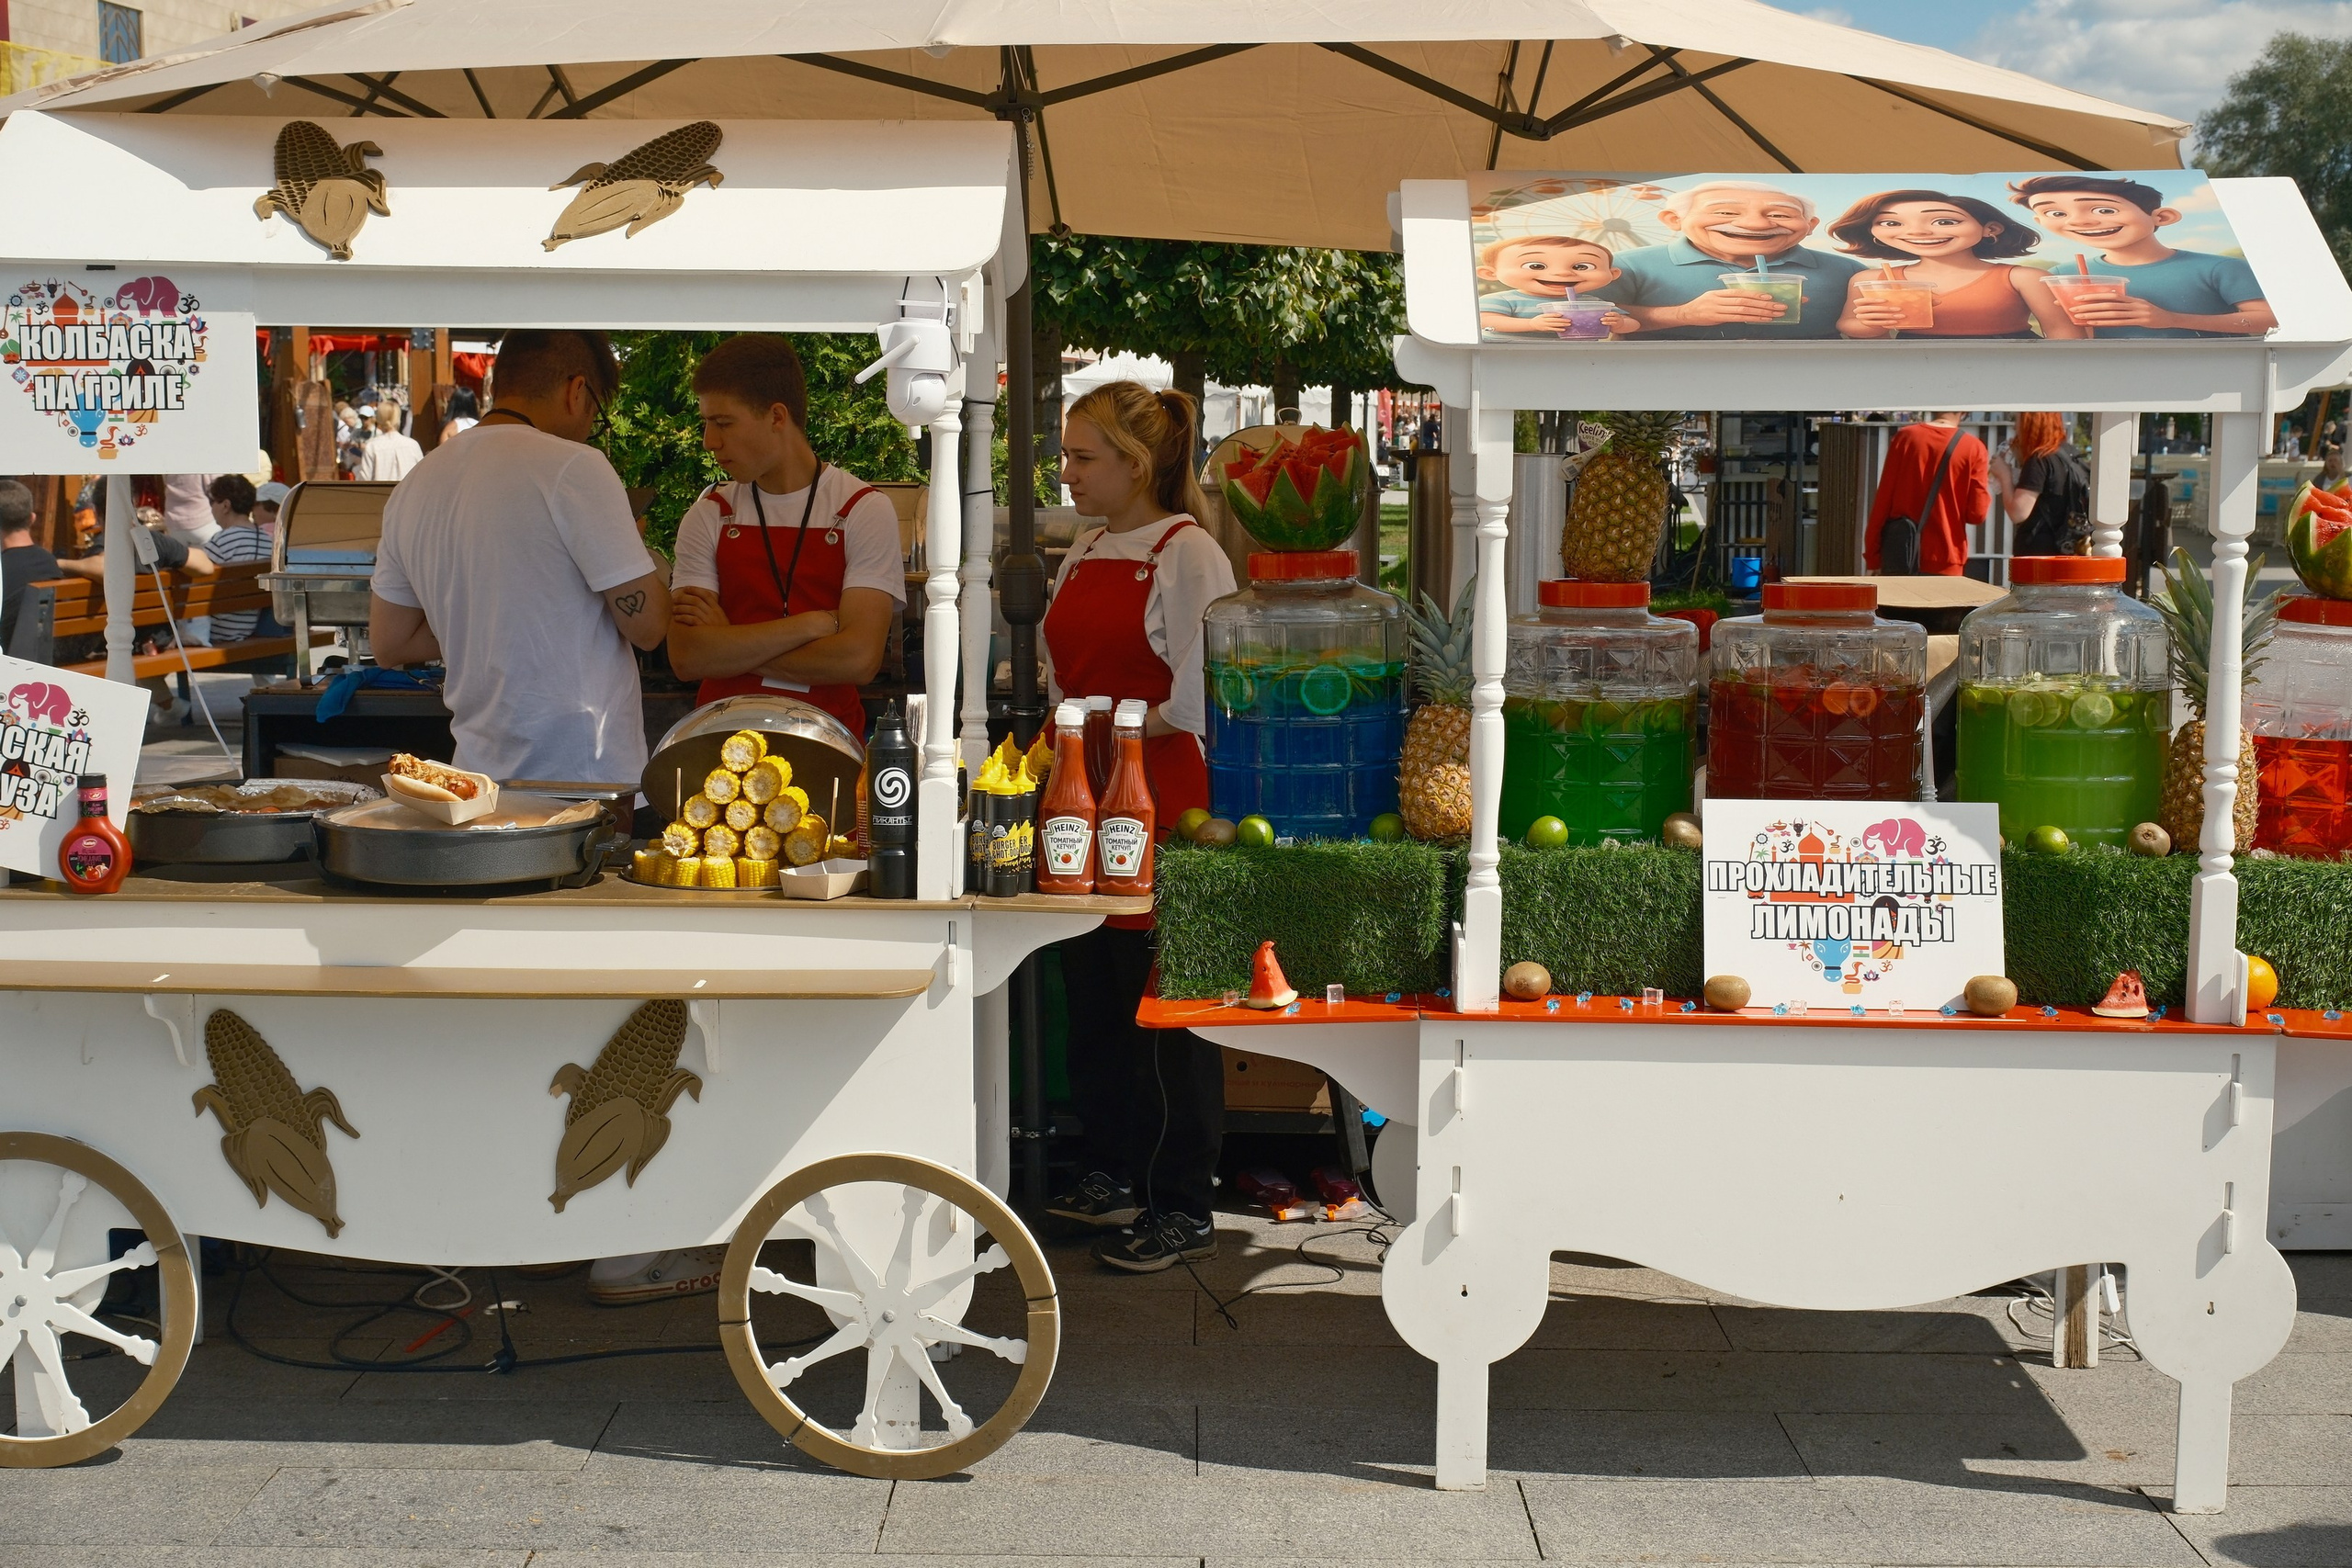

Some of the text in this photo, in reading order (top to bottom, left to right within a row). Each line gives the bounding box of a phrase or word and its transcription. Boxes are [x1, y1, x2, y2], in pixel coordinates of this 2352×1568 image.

[19, 323, 197, 361] КОЛБАСКА
[33, 374, 185, 411] НА ГРИЛЕ
[1579, 423, 1607, 439] Keelin
[0, 715, 90, 775] СКАЯ
[992, 839, 1017, 851] BURGER
[1054, 823, 1080, 833] HEINZ
[1109, 824, 1136, 835] HEINZ
[1708, 860, 1997, 897] ПРОХЛАДИТЕЛЬНЫЕ
[1750, 904, 1955, 947] ЛИМОНАДЫ
